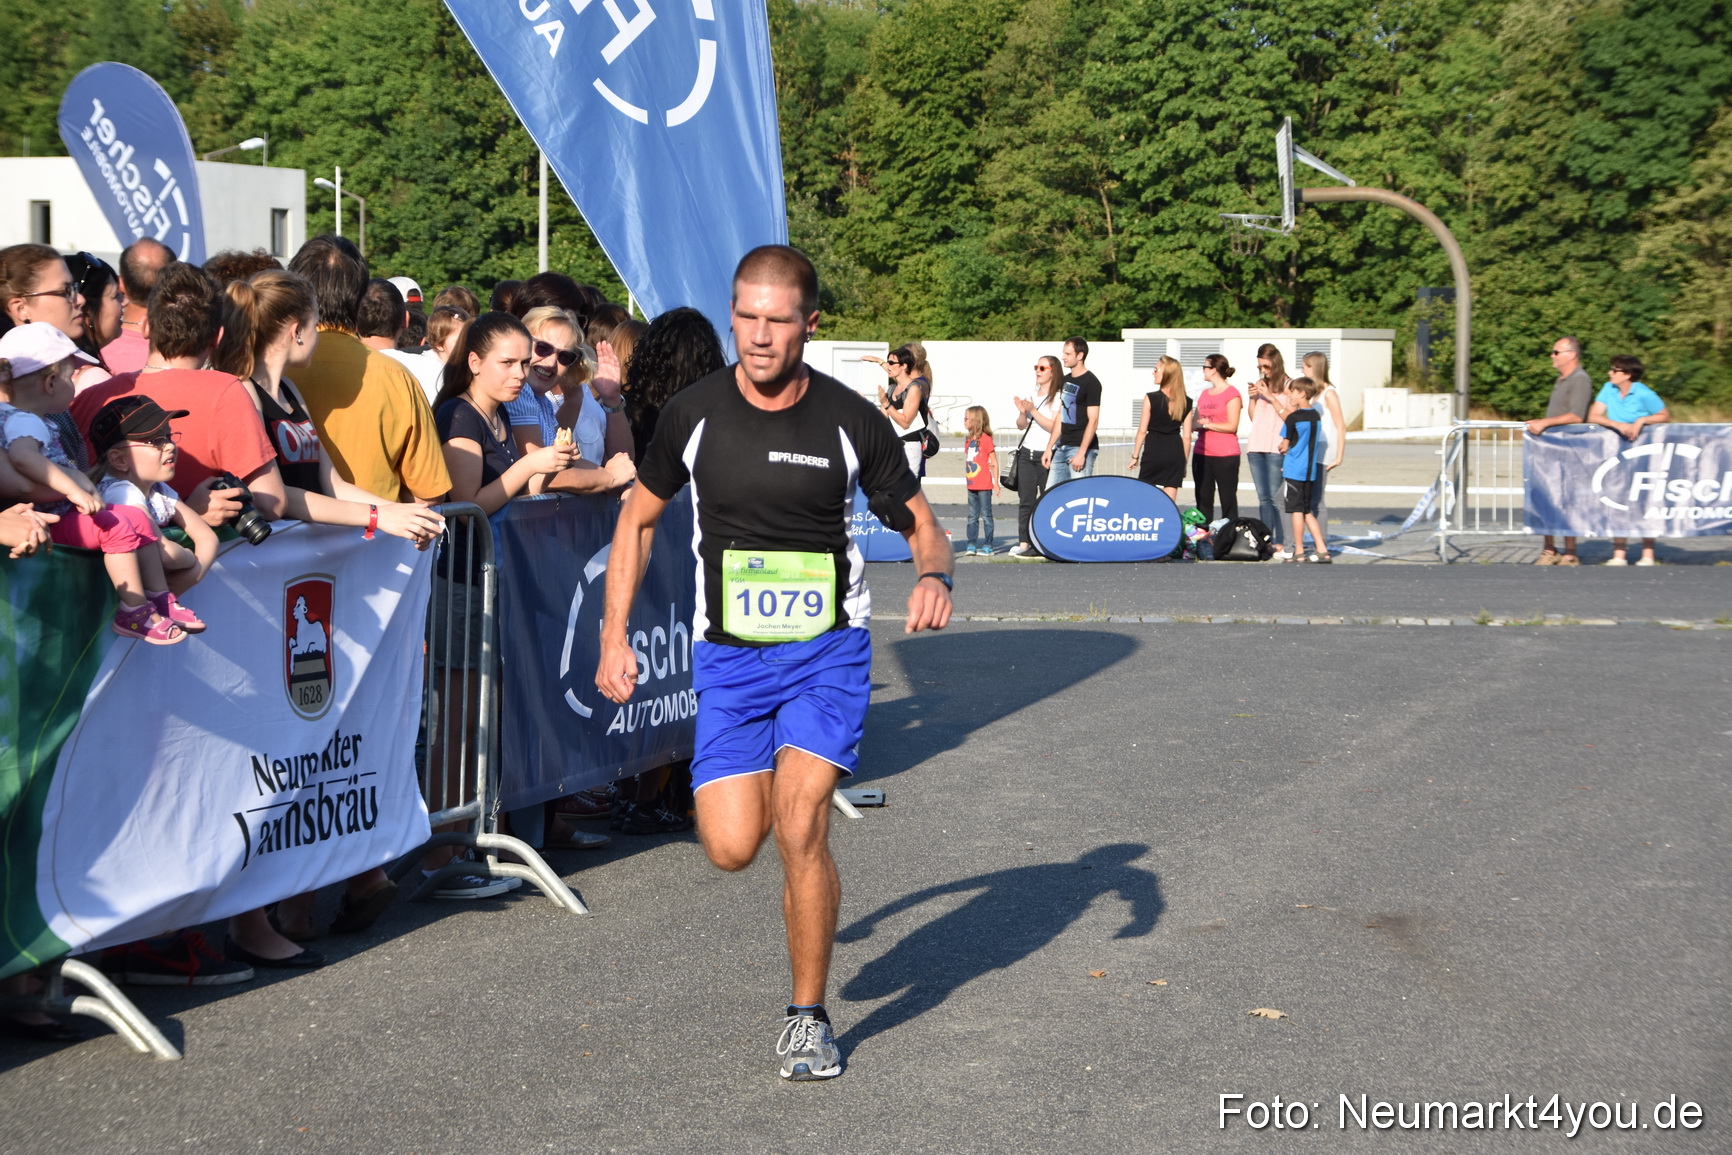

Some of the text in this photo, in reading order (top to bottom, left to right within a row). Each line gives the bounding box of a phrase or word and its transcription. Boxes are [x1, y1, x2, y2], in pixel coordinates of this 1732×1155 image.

[779, 452, 829, 469] PFLEIDERER
[1072, 513, 1164, 533] Fischer
[1082, 533, 1158, 542] AUTOMOBILE
[736, 588, 824, 617] 1079
[299, 685, 322, 706] 1628
